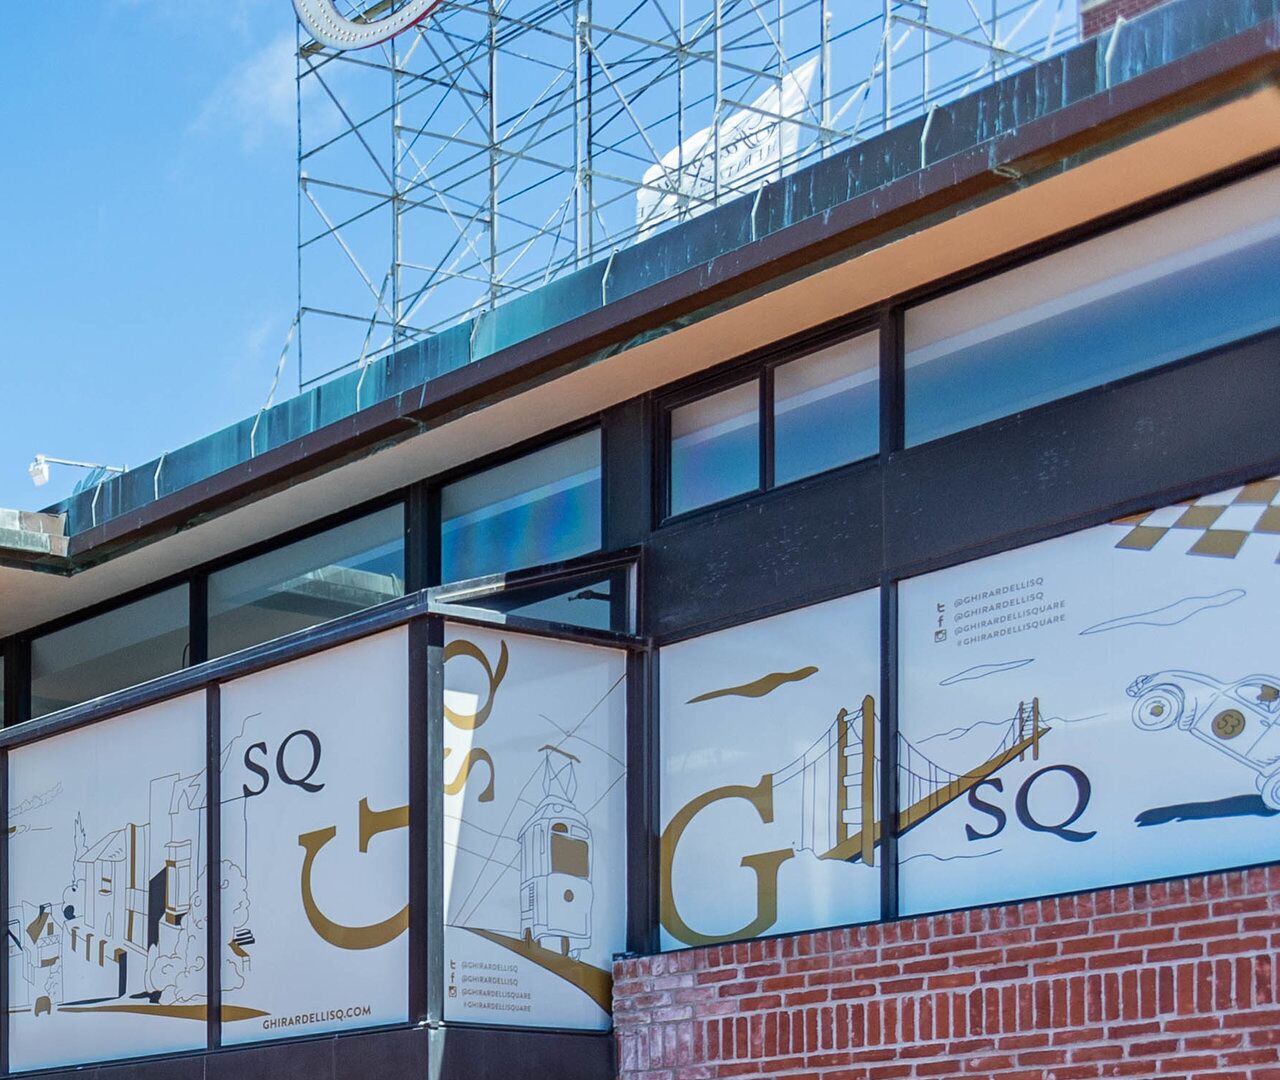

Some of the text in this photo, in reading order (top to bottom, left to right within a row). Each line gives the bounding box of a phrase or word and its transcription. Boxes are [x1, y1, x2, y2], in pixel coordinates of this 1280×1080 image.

[954, 577, 1044, 608] @GHIRARDELLISQ
[954, 591, 1044, 623] @GHIRARDELLISQ
[954, 600, 1066, 636] @GHIRARDELLISQUARE
[957, 614, 1066, 646] #GHIRARDELLISQUARE
[1217, 713, 1241, 735] 53
[243, 729, 326, 796] SQ
[660, 764, 1098, 946] G SQ
[461, 961, 519, 973] @GHIRARDELLISQ
[461, 975, 519, 987] @GHIRARDELLISQ
[262, 1005, 372, 1030] GHIRARDELLISQ.COM
